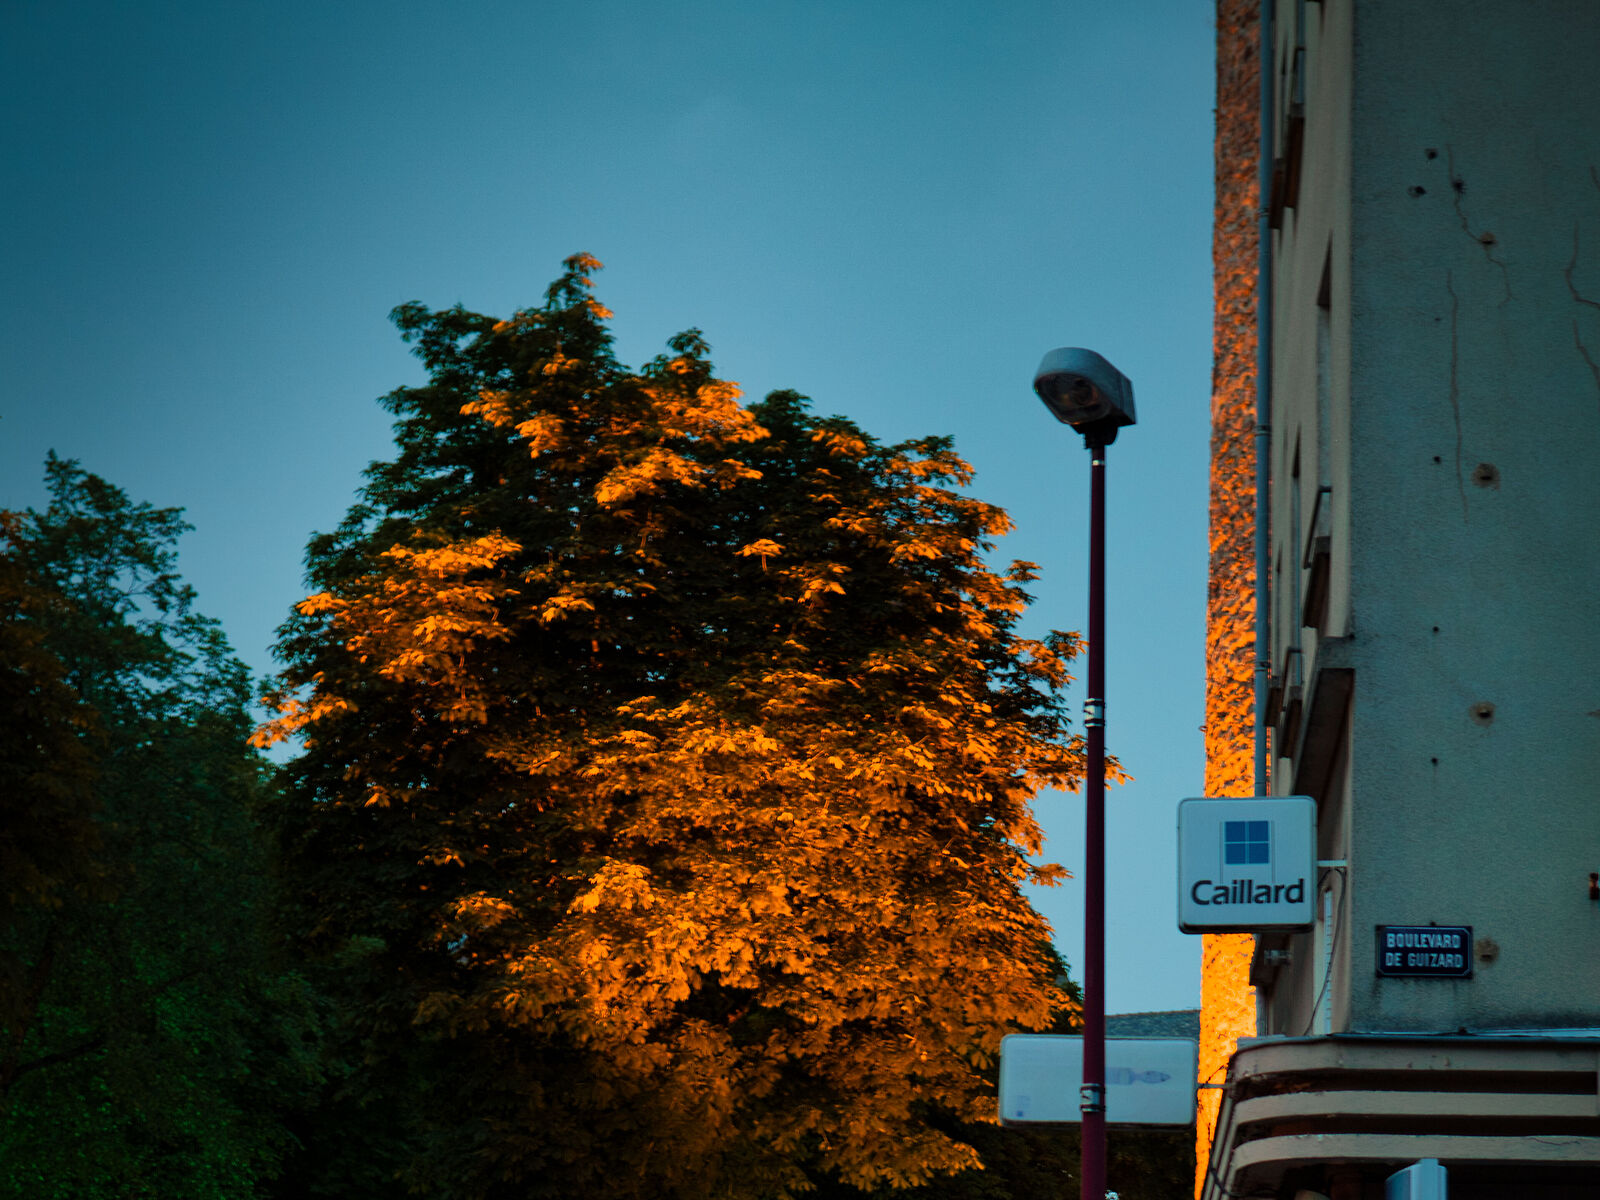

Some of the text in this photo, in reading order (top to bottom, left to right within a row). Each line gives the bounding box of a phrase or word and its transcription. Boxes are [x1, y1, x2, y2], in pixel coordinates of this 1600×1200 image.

[1191, 878, 1304, 905] Caillard
[1386, 932, 1461, 949] BOULEVARD
[1385, 952, 1464, 969] DE GUIZARD
